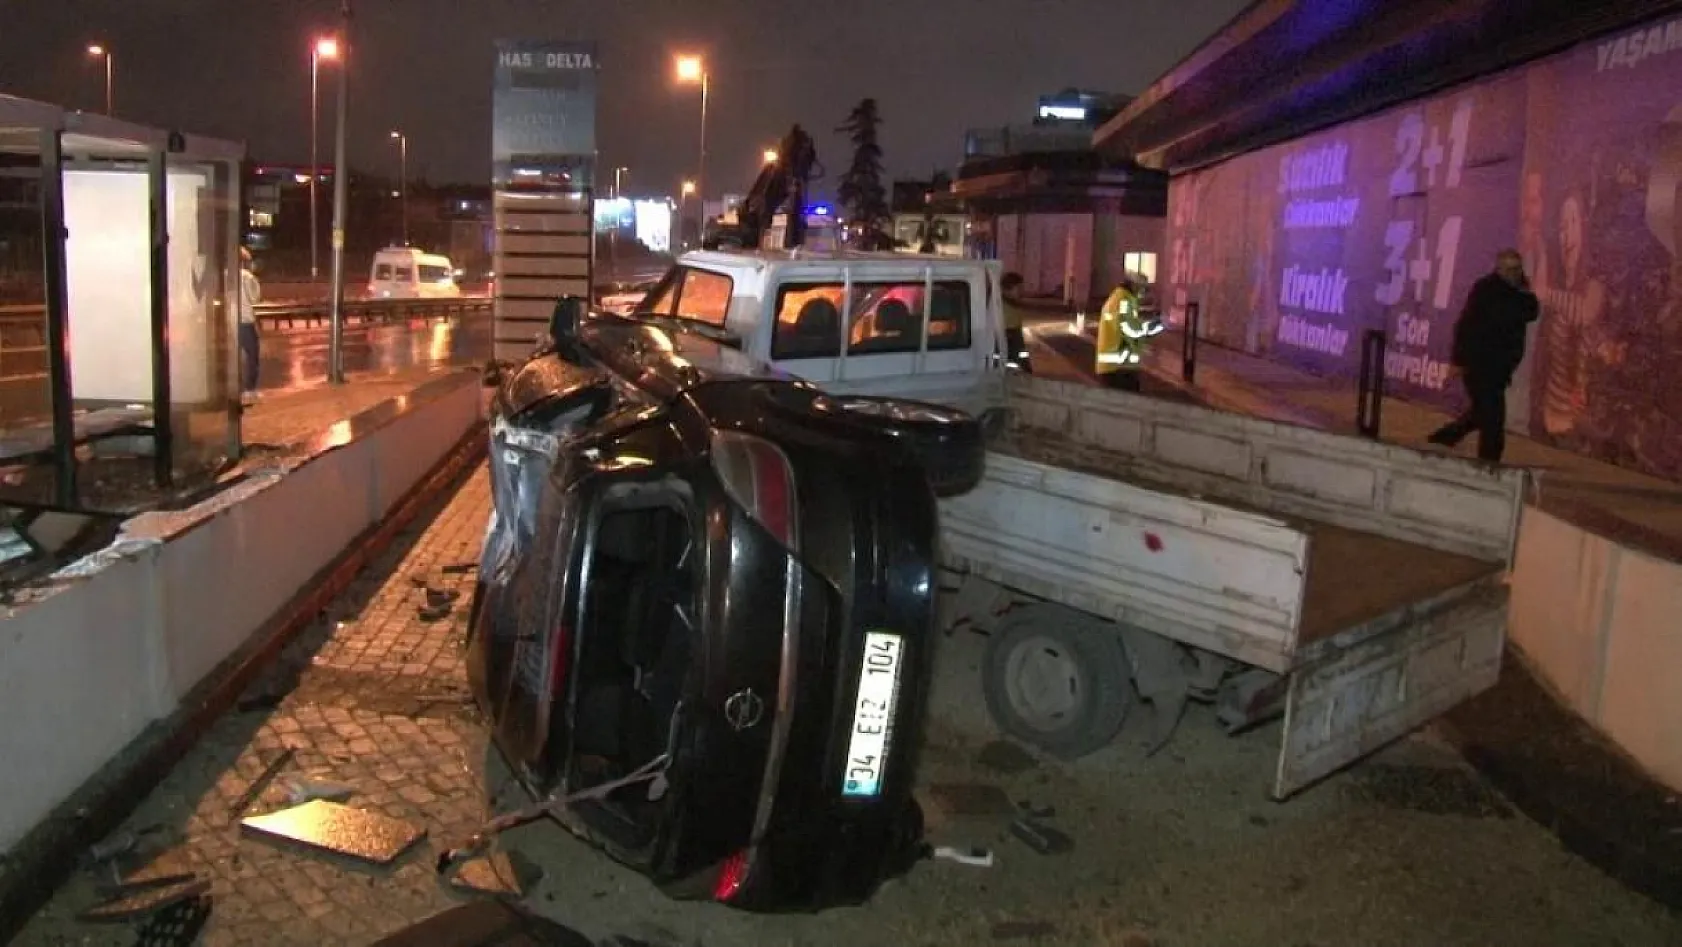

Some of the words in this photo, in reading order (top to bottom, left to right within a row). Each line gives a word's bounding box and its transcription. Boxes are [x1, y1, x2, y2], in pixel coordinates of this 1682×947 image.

[546, 53, 592, 69] DELTA
[1389, 101, 1471, 195] 2+1
[1375, 215, 1463, 309] 3+1
[1395, 312, 1431, 347] Son
[1384, 352, 1451, 391] aireler
[850, 754, 876, 780] 34
[867, 641, 896, 676] 104
